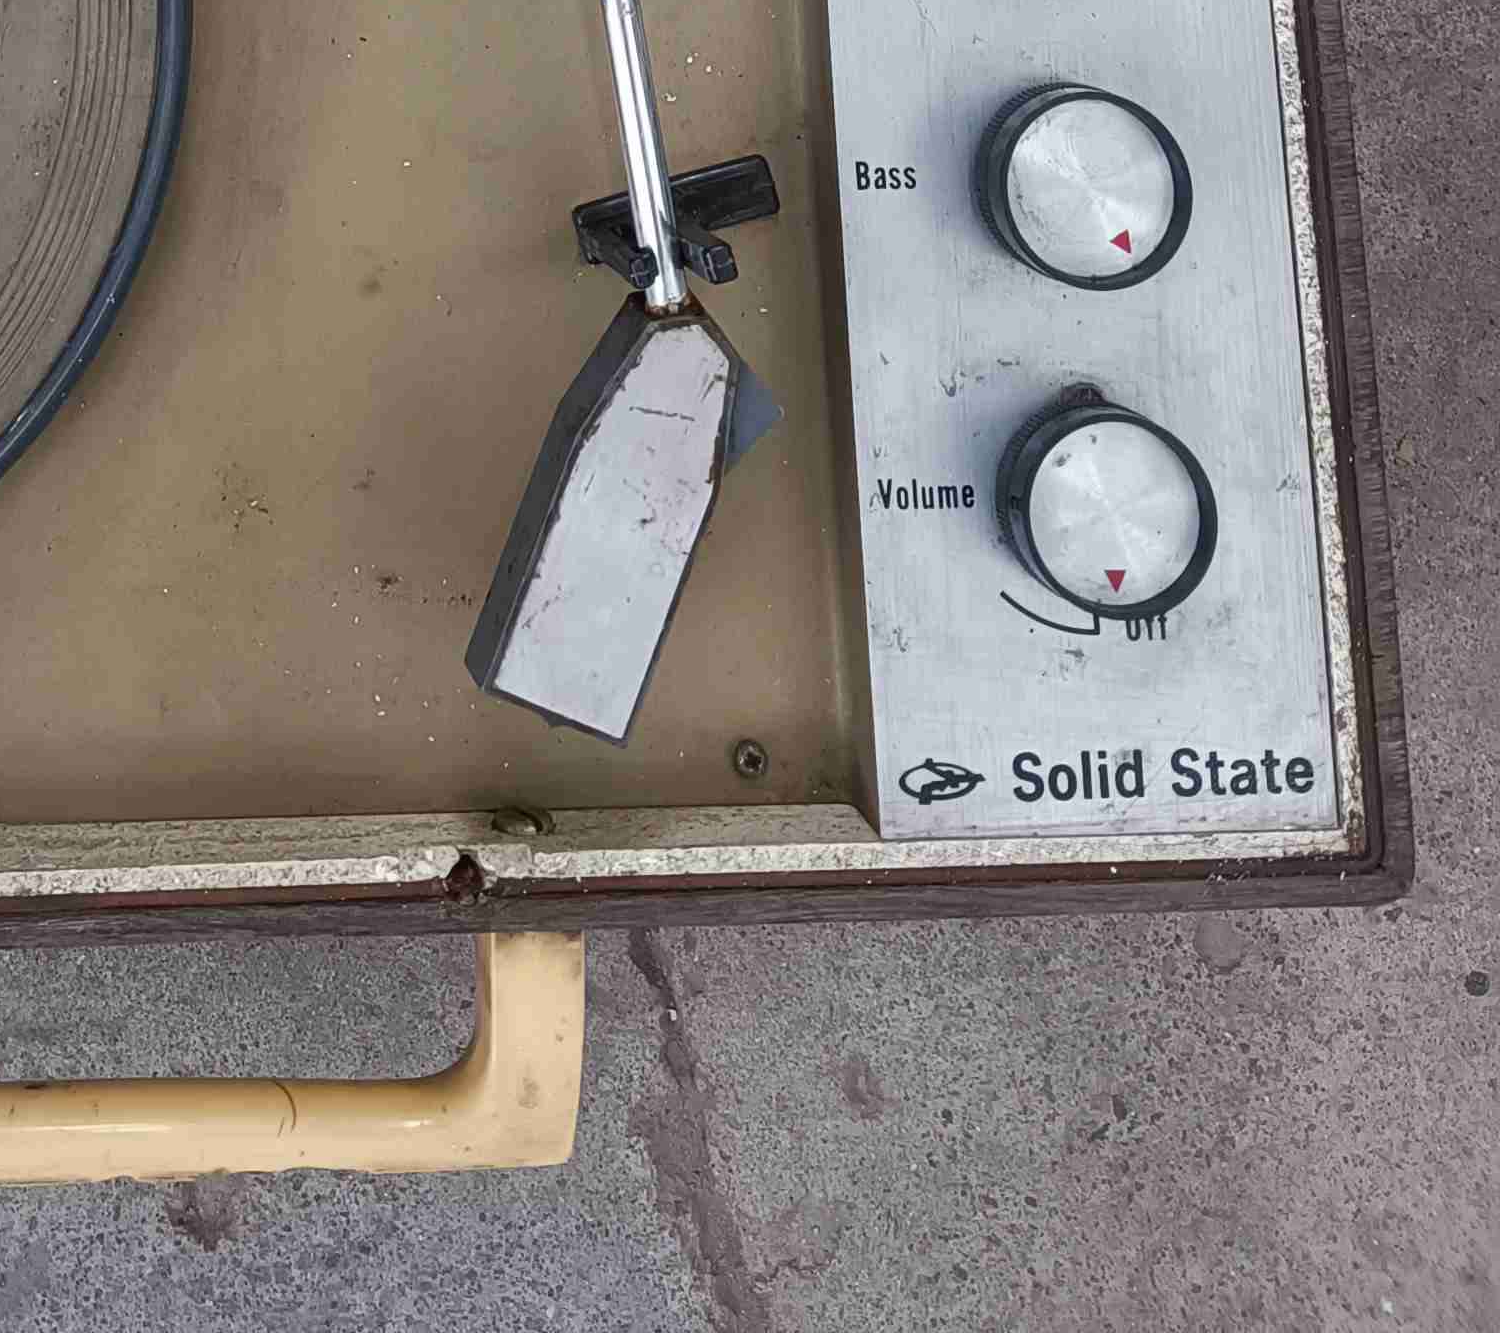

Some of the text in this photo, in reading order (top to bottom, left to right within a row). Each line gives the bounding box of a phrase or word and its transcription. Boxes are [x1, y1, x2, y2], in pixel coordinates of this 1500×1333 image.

[856, 161, 917, 190] Bass
[877, 478, 975, 510] Volume
[1012, 748, 1315, 802] Solid State
